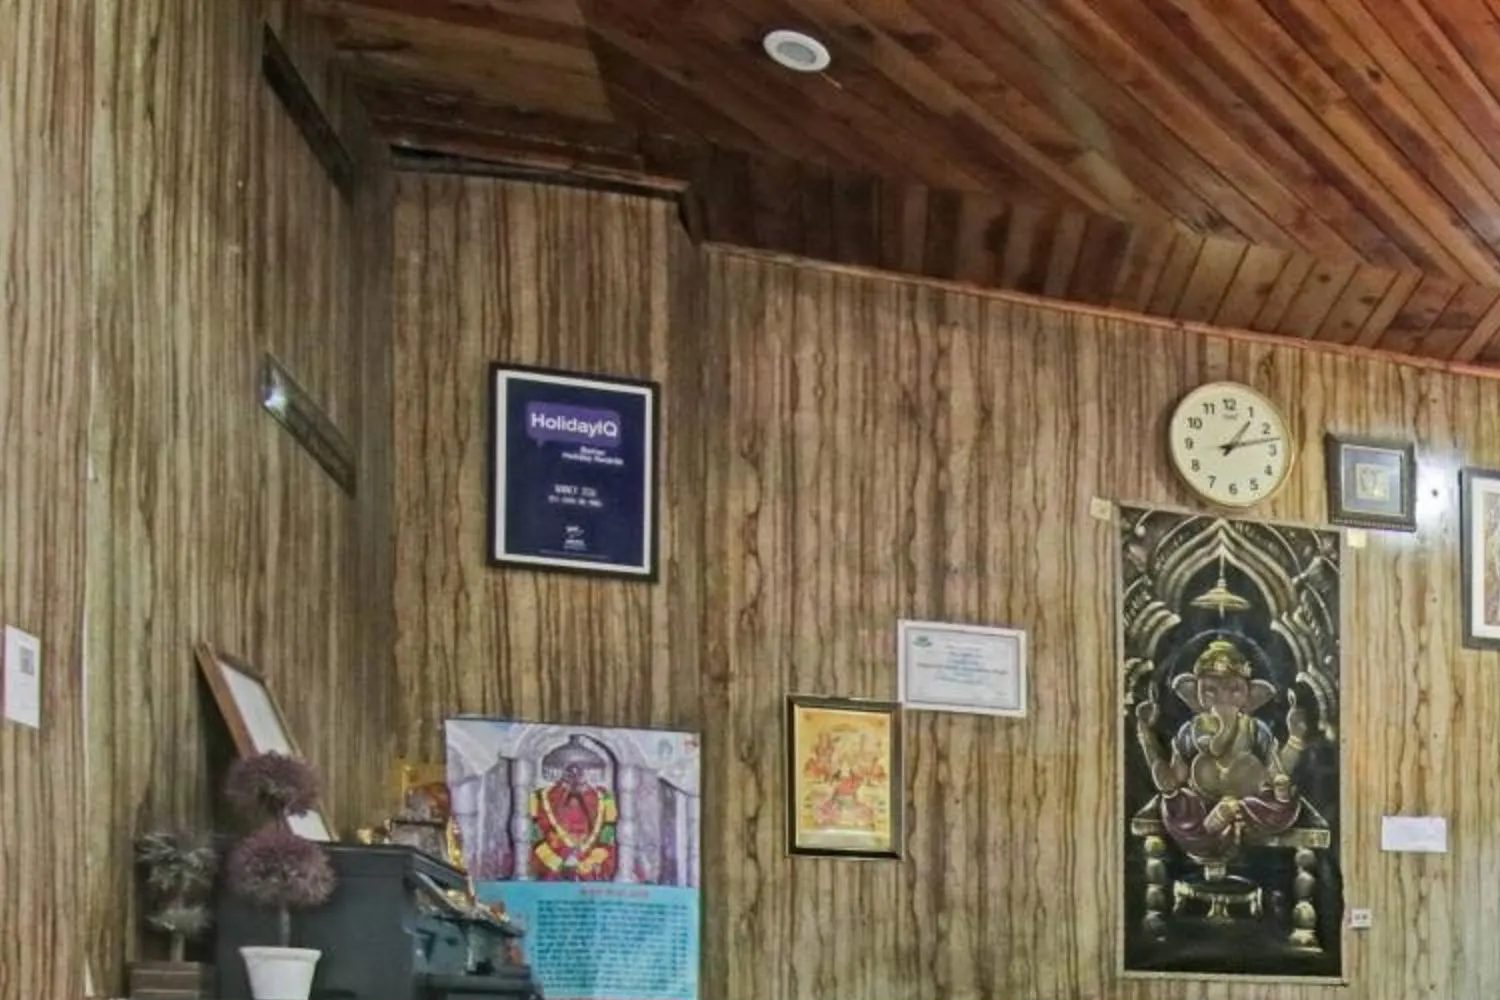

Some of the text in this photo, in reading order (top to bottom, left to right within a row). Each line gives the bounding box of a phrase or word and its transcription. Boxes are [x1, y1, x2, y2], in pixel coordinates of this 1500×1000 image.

[1202, 402, 1216, 416] 11
[1222, 398, 1237, 411] 12
[1248, 406, 1254, 418] 1
[530, 412, 618, 439] HolidayIQ
[1187, 417, 1203, 430] 10
[1262, 422, 1271, 435] 2
[1185, 437, 1194, 450] 9
[1268, 444, 1277, 457] 3
[1191, 459, 1200, 472] 8
[1264, 464, 1273, 476] 4
[1208, 475, 1217, 489] 7
[1249, 478, 1259, 491] 5
[1228, 483, 1238, 495] 6
